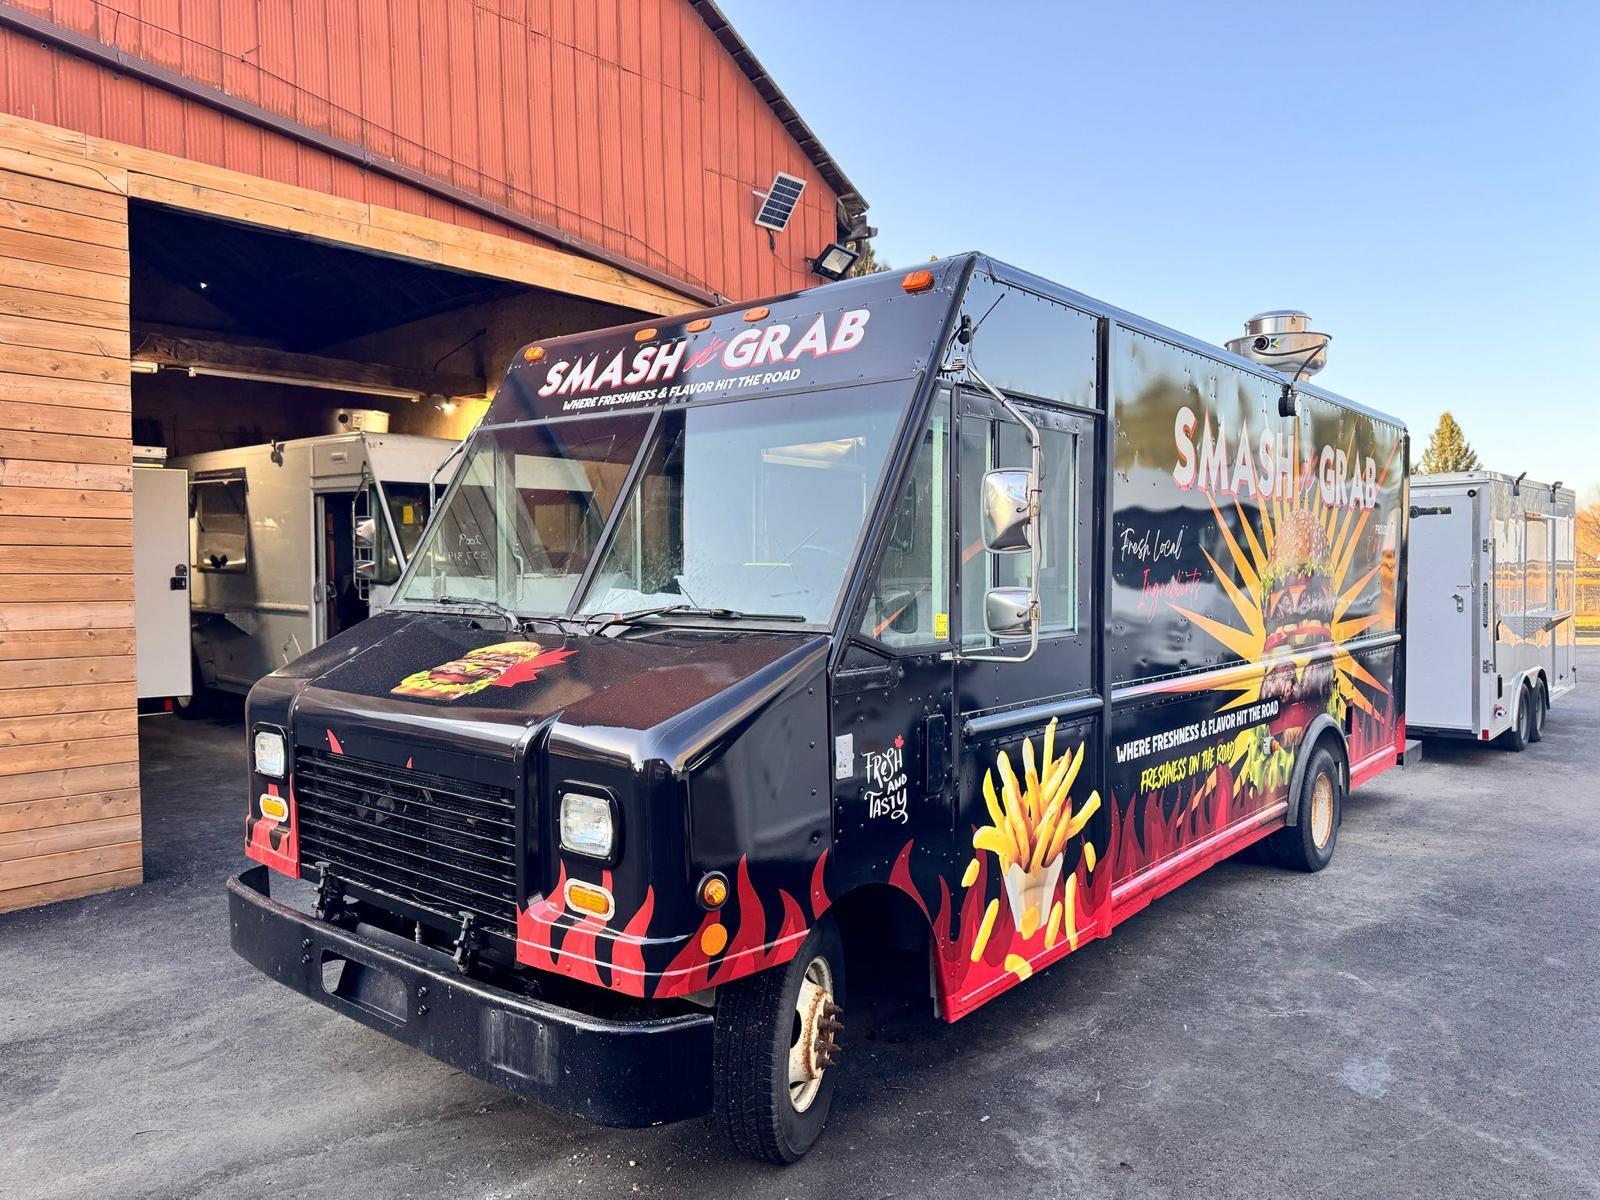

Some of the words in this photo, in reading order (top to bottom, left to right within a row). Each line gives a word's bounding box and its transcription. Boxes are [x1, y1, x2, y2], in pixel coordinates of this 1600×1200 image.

[537, 341, 688, 398] SMASH
[722, 309, 871, 369] GRAB
[563, 397, 599, 411] WHERE
[598, 389, 657, 406] FRESHNESS
[657, 387, 668, 399] &
[668, 381, 716, 398] FLAVOR
[715, 378, 737, 391] HIT
[739, 374, 762, 387] THE
[762, 368, 801, 385] ROAD
[1173, 406, 1294, 500] SMASH
[1319, 445, 1377, 511] GRAB
[1120, 527, 1152, 562] Fresh
[1153, 529, 1183, 561] Local
[1115, 738, 1151, 764] WHERE
[1151, 722, 1199, 752] FRESHNESS
[1200, 721, 1208, 737] &
[1208, 713, 1236, 736] FLAVOR
[1236, 709, 1248, 726] HIT
[1248, 706, 1261, 722] THE
[1260, 700, 1279, 719] ROAD
[886, 773, 908, 794] AND
[1140, 758, 1187, 795] FRESHNESS
[1188, 754, 1199, 773] ON
[1202, 747, 1215, 771] THE
[1215, 739, 1236, 766] ROAD
